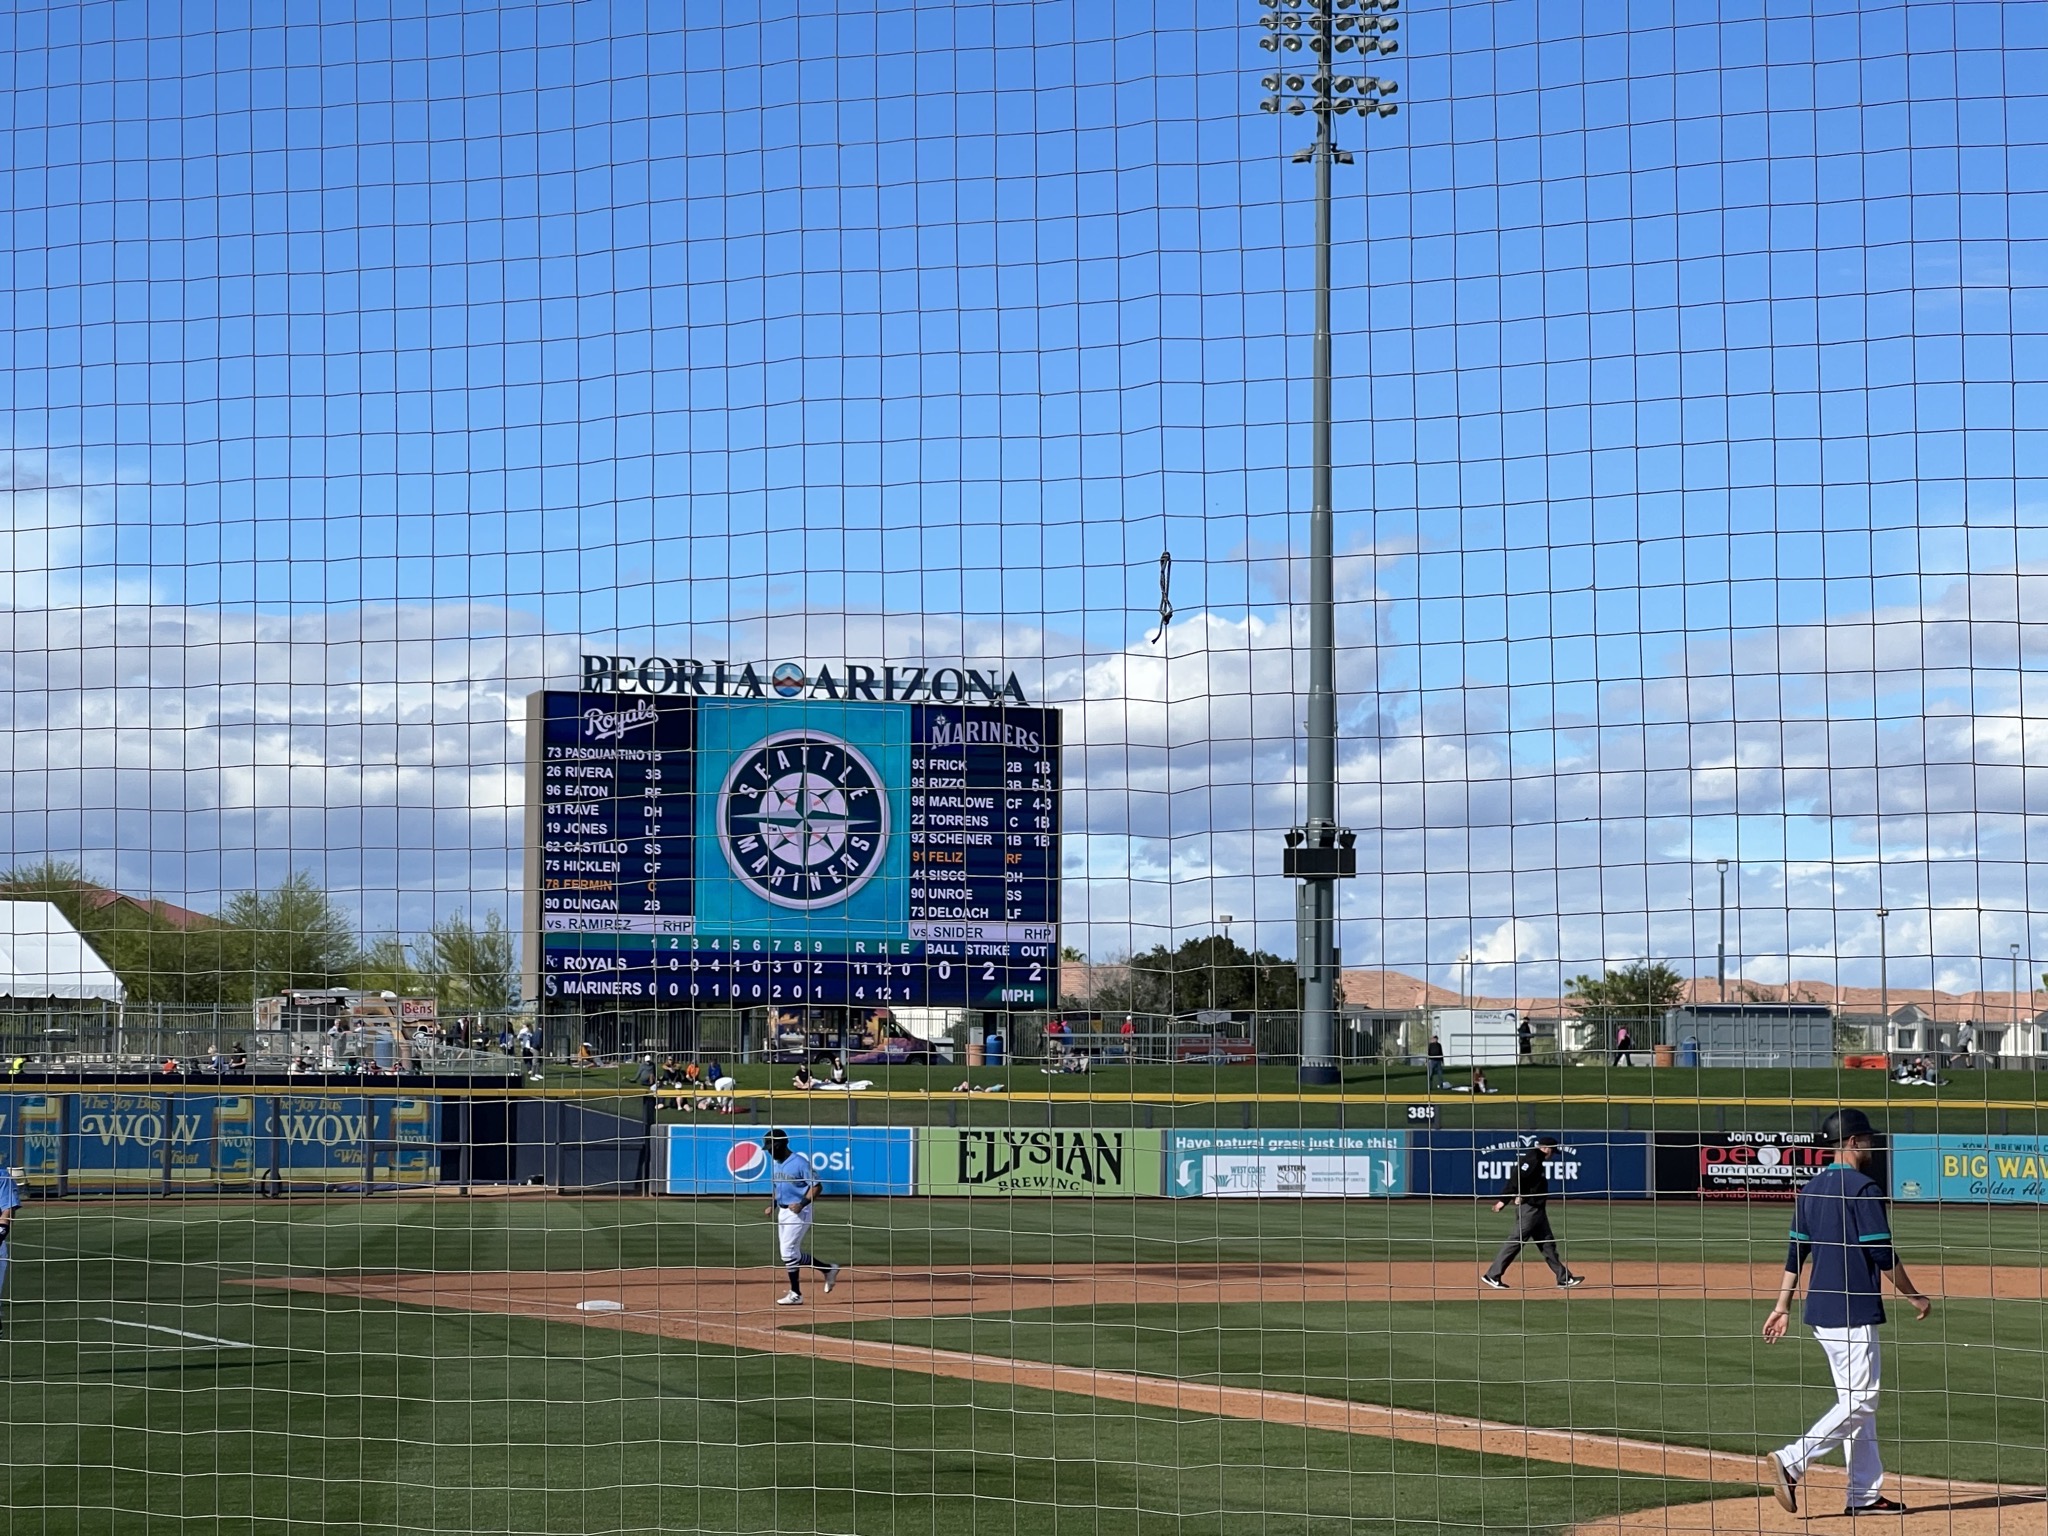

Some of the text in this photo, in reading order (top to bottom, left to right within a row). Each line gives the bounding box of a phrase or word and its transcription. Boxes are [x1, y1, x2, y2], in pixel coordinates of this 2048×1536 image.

[581, 655, 1030, 706] PEORIA ARIZONA
[584, 699, 659, 739] Royals
[931, 721, 1040, 754] MARINERS
[547, 747, 662, 762] 73 PASQUANTINO 1B
[546, 766, 661, 780] 26 RIVERA 3B
[738, 746, 868, 801] SEATTLE
[912, 759, 1051, 774] 93 FRICK 2B 1B
[546, 785, 662, 799] 96 EATON RF
[912, 778, 1051, 792] 95 RIZZO 3B 5-3
[912, 796, 1051, 810] 98 MARLOWE CF 4-3
[548, 804, 662, 818] 81 RAVE DH
[912, 815, 1050, 829] 22 TORRENS C 1B
[546, 823, 661, 836] 19 JONES LF
[912, 834, 924, 844] 92
[1007, 835, 1022, 846] 1B
[1034, 835, 1050, 847] 1B
[545, 842, 661, 855] 62 CASTILLO SS
[737, 836, 870, 891] MARINERS
[912, 851, 1022, 864] 91 FELIZ RF
[545, 861, 661, 874] 75 HICKLEN CF
[912, 870, 1023, 883] 41 SISCO DH
[545, 880, 657, 892] 78 FERMIN C
[911, 888, 1022, 901] 90 UNROE SS
[545, 899, 660, 911] 90 DUNGAN 2B
[911, 907, 1021, 919] 73 DELOACH LF
[569, 919, 632, 931] RAMIREZ
[664, 921, 691, 931] RHP
[934, 927, 983, 938] SNIDER
[1025, 929, 1051, 940] RHP
[650, 939, 910, 954] 1 2 3 4 5 6 7 8 9 R H E
[927, 943, 1047, 957] BALL STRIKE OUT
[564, 957, 910, 976] ROYALS 1 0 0 4 1 0 3 0 2 11 12 0
[938, 960, 1041, 982] 0 2 2
[564, 982, 909, 1000] MARINERS 0 0 0 1 0 0 2 0 1 4 12 1
[1001, 989, 1034, 1002] MPH
[82, 1096, 107, 1109] The
[111, 1096, 132, 1113] Joy
[1408, 1106, 1434, 1119] 385
[82, 1114, 201, 1146] WOW
[265, 1115, 379, 1146] WOW
[1176, 1137, 1397, 1152] Have natural grass just like this!
[1727, 1133, 1814, 1143] Join Our Team!
[958, 1131, 1122, 1185] ELYSIAN
[1230, 1166, 1247, 1174] WEST
[1477, 1161, 1578, 1180] CUTTER
[1944, 1155, 1988, 1179] BIG
[998, 1176, 1080, 1193] BREWING
[1231, 1174, 1266, 1188] TURF
[1969, 1181, 2046, 1196] Golden Ale
